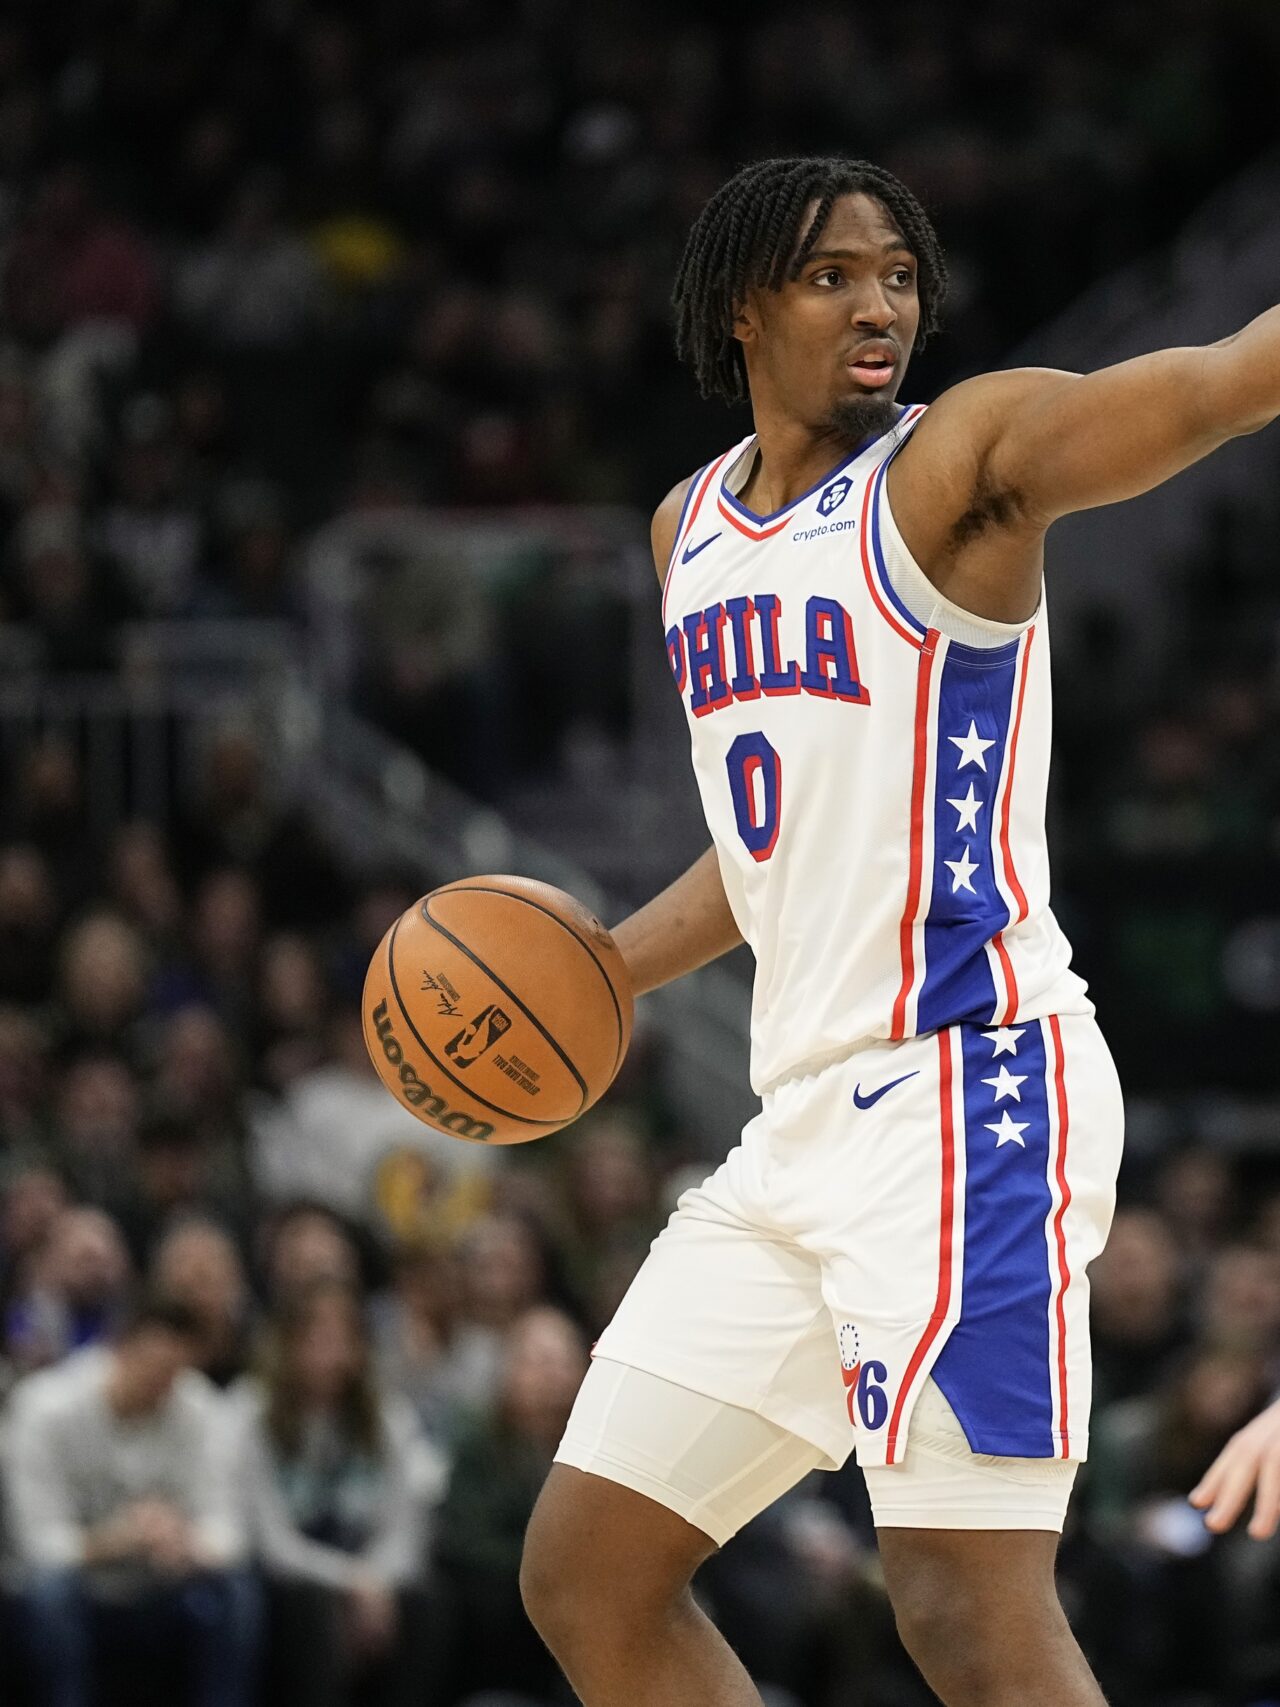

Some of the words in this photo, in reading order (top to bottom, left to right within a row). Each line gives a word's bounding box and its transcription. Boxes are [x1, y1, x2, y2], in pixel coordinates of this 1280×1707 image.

[793, 519, 856, 542] crypto.com
[665, 593, 871, 718] PHILA
[725, 731, 782, 862] 0
[373, 998, 495, 1140] Wilson
[491, 1012, 509, 1031] NBA
